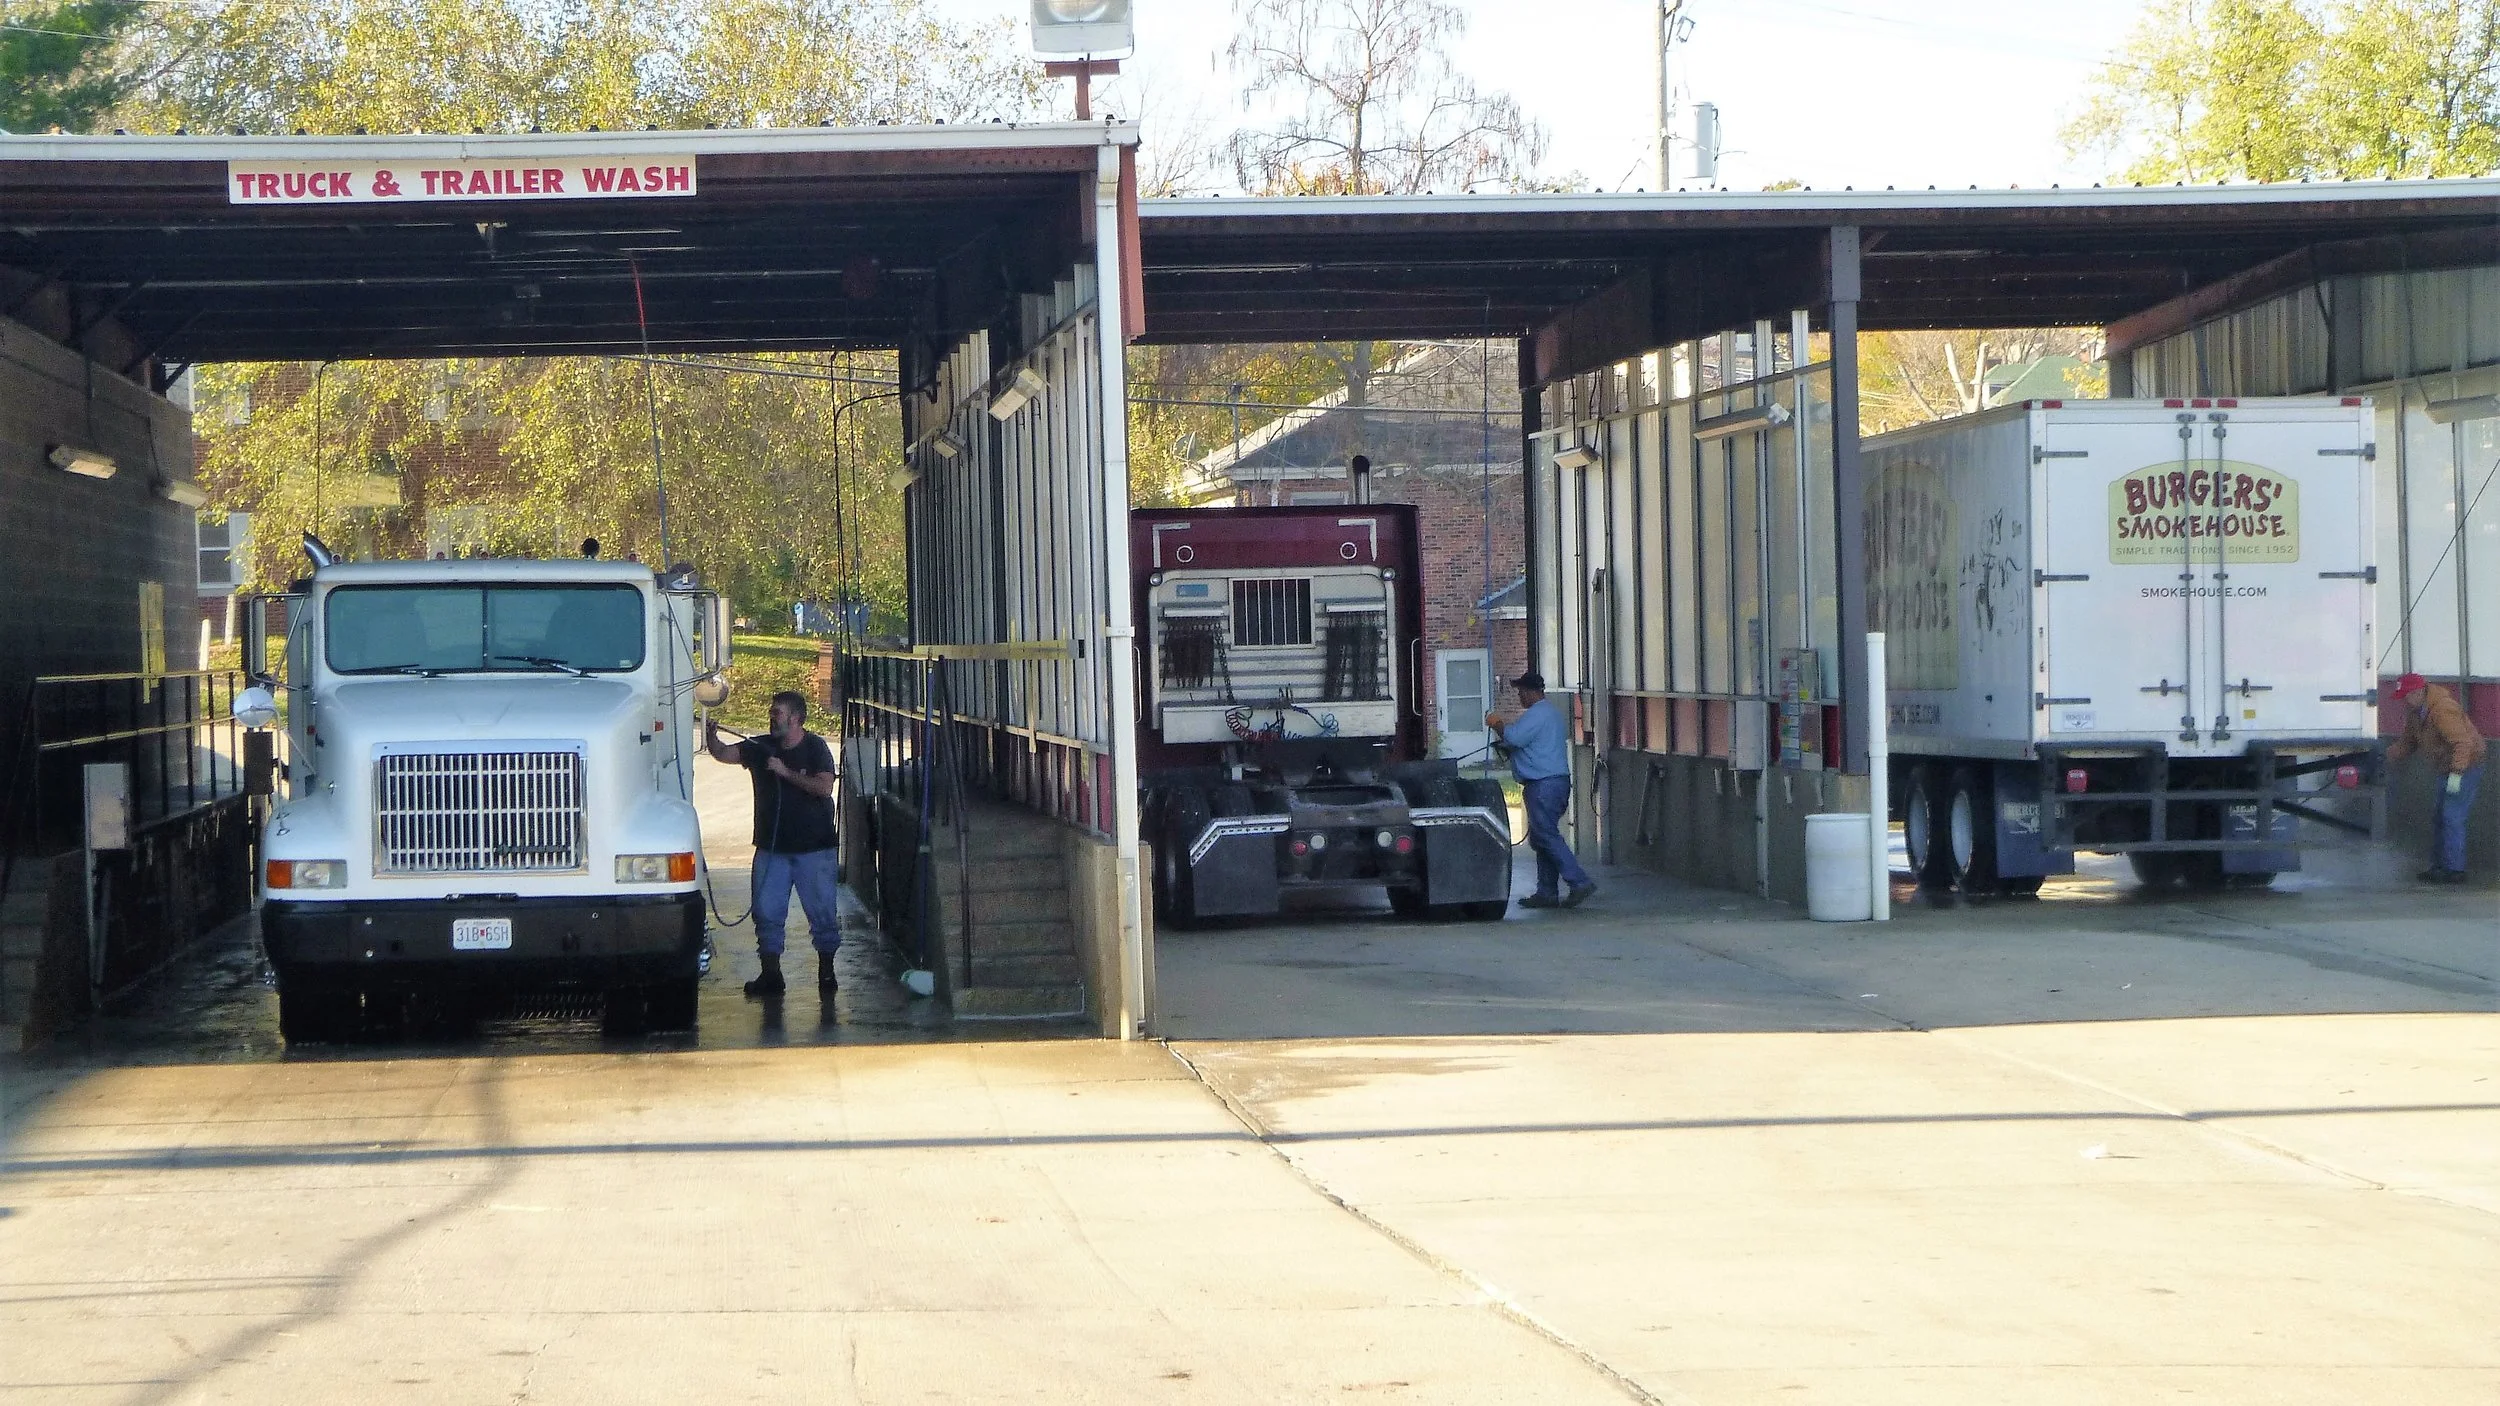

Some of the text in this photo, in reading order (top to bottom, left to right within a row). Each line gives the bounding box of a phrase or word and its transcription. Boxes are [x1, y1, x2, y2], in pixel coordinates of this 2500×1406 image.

[236, 166, 690, 199] TRUCK & TRAILER WASH
[2117, 514, 2286, 540] SMOKEHOUSE
[2115, 545, 2293, 556] SIMPLE TRADTIONS SINCE 1952
[2141, 587, 2268, 598] SMOKEHOUSE.COM
